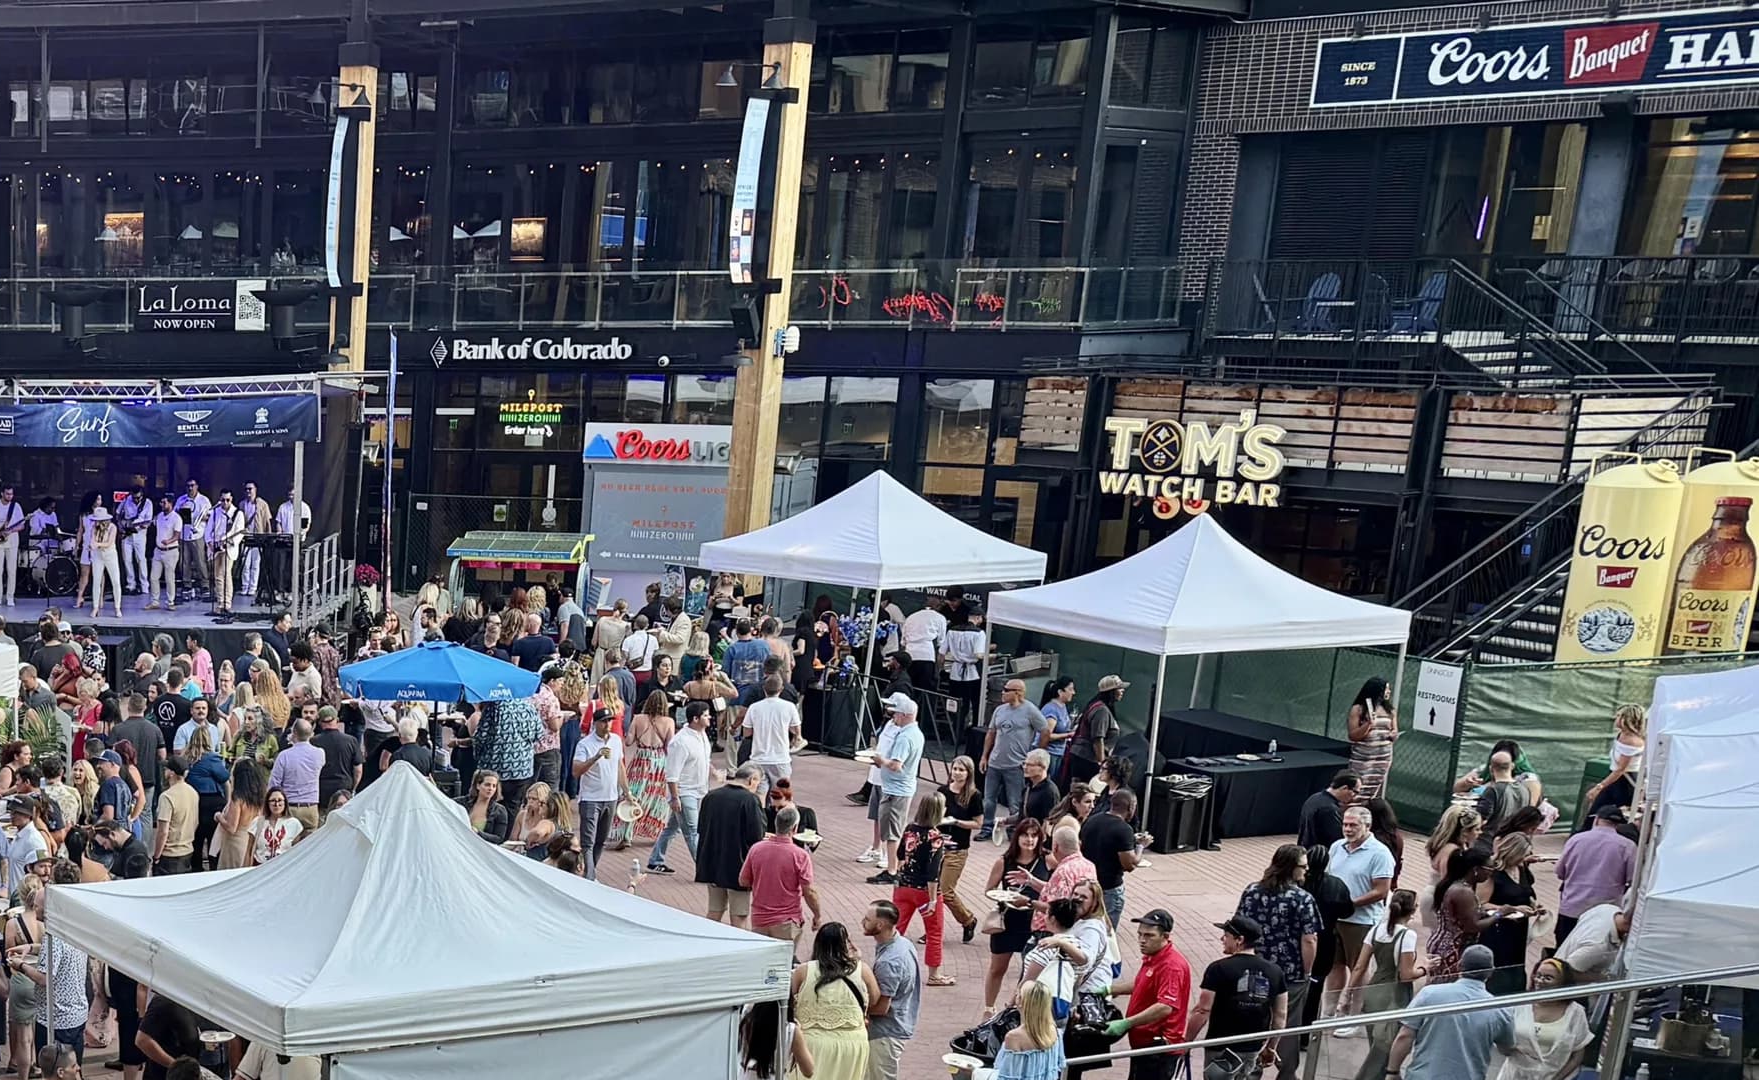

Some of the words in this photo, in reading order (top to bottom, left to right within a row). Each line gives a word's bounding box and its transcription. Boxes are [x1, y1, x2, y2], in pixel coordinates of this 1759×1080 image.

[1428, 38, 1550, 84] Coors
[1569, 29, 1649, 79] Banquet
[1341, 62, 1376, 72] SINCE
[1344, 75, 1368, 85] 1873
[138, 285, 165, 312] La
[170, 285, 231, 312] Loma
[153, 319, 182, 329] NOW
[184, 319, 216, 329] OPEN
[452, 338, 506, 360] Bank
[507, 338, 532, 360] of
[533, 338, 632, 360] Colorado
[500, 403, 563, 413] MILEPOST
[56, 404, 116, 442] Surf
[517, 414, 541, 423] ZERO
[505, 425, 526, 435] Enter
[616, 430, 691, 460] Coors
[693, 441, 730, 461] LIG
[1099, 471, 1205, 501] WATCH
[1215, 479, 1281, 507] BAR
[632, 520, 696, 529] MILEPOST
[649, 531, 675, 539] ZERO
[1579, 524, 1667, 561] Coors
[1599, 568, 1635, 585] Banquet
[1678, 592, 1730, 611] Coors
[1671, 635, 1722, 647] BEER
[396, 690, 426, 699] AQUAFINA
[1417, 690, 1456, 705] RESTROOMS
